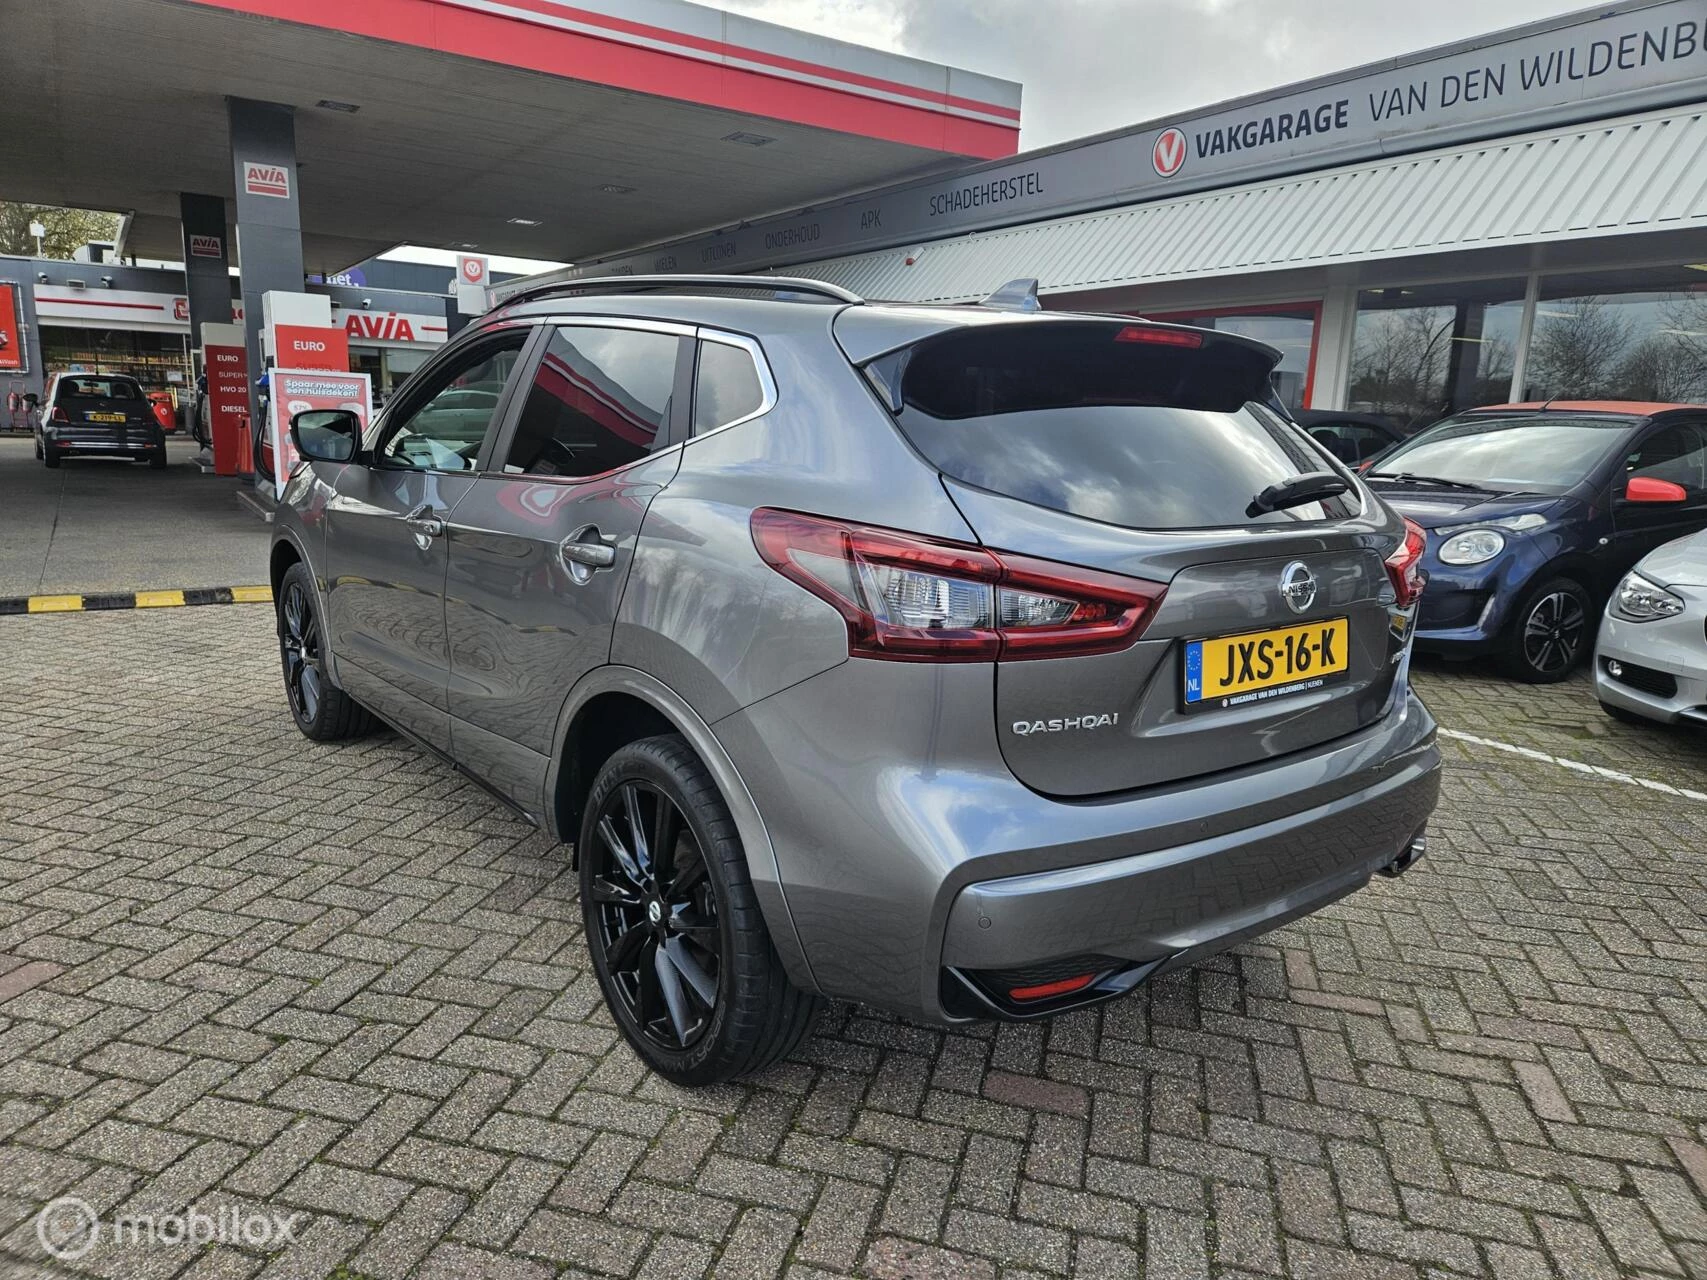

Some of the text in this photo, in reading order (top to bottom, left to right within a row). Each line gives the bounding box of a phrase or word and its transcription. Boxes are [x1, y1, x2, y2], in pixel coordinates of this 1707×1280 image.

[1196, 99, 1349, 158] VAKGARAGE
[1369, 81, 1427, 121] VAN
[1440, 63, 1506, 108] DEN
[1520, 18, 1707, 90] WILDENB
[929, 172, 1044, 216] SCHADEHERSTEL
[860, 209, 882, 230] APK
[765, 224, 821, 249] ONDERHOUD
[294, 340, 326, 351] EURO
[217, 354, 239, 362] EURO
[221, 405, 248, 413] DIESEL
[1219, 628, 1336, 687] JXS-16-K
[1187, 678, 1200, 692] NL
[1230, 692, 1258, 705] VAKGARAGE
[1258, 690, 1268, 699] VAN
[1268, 688, 1278, 697] DEN
[1278, 683, 1305, 695] WILDENBERG
[1012, 713, 1119, 736] QASHQAI
